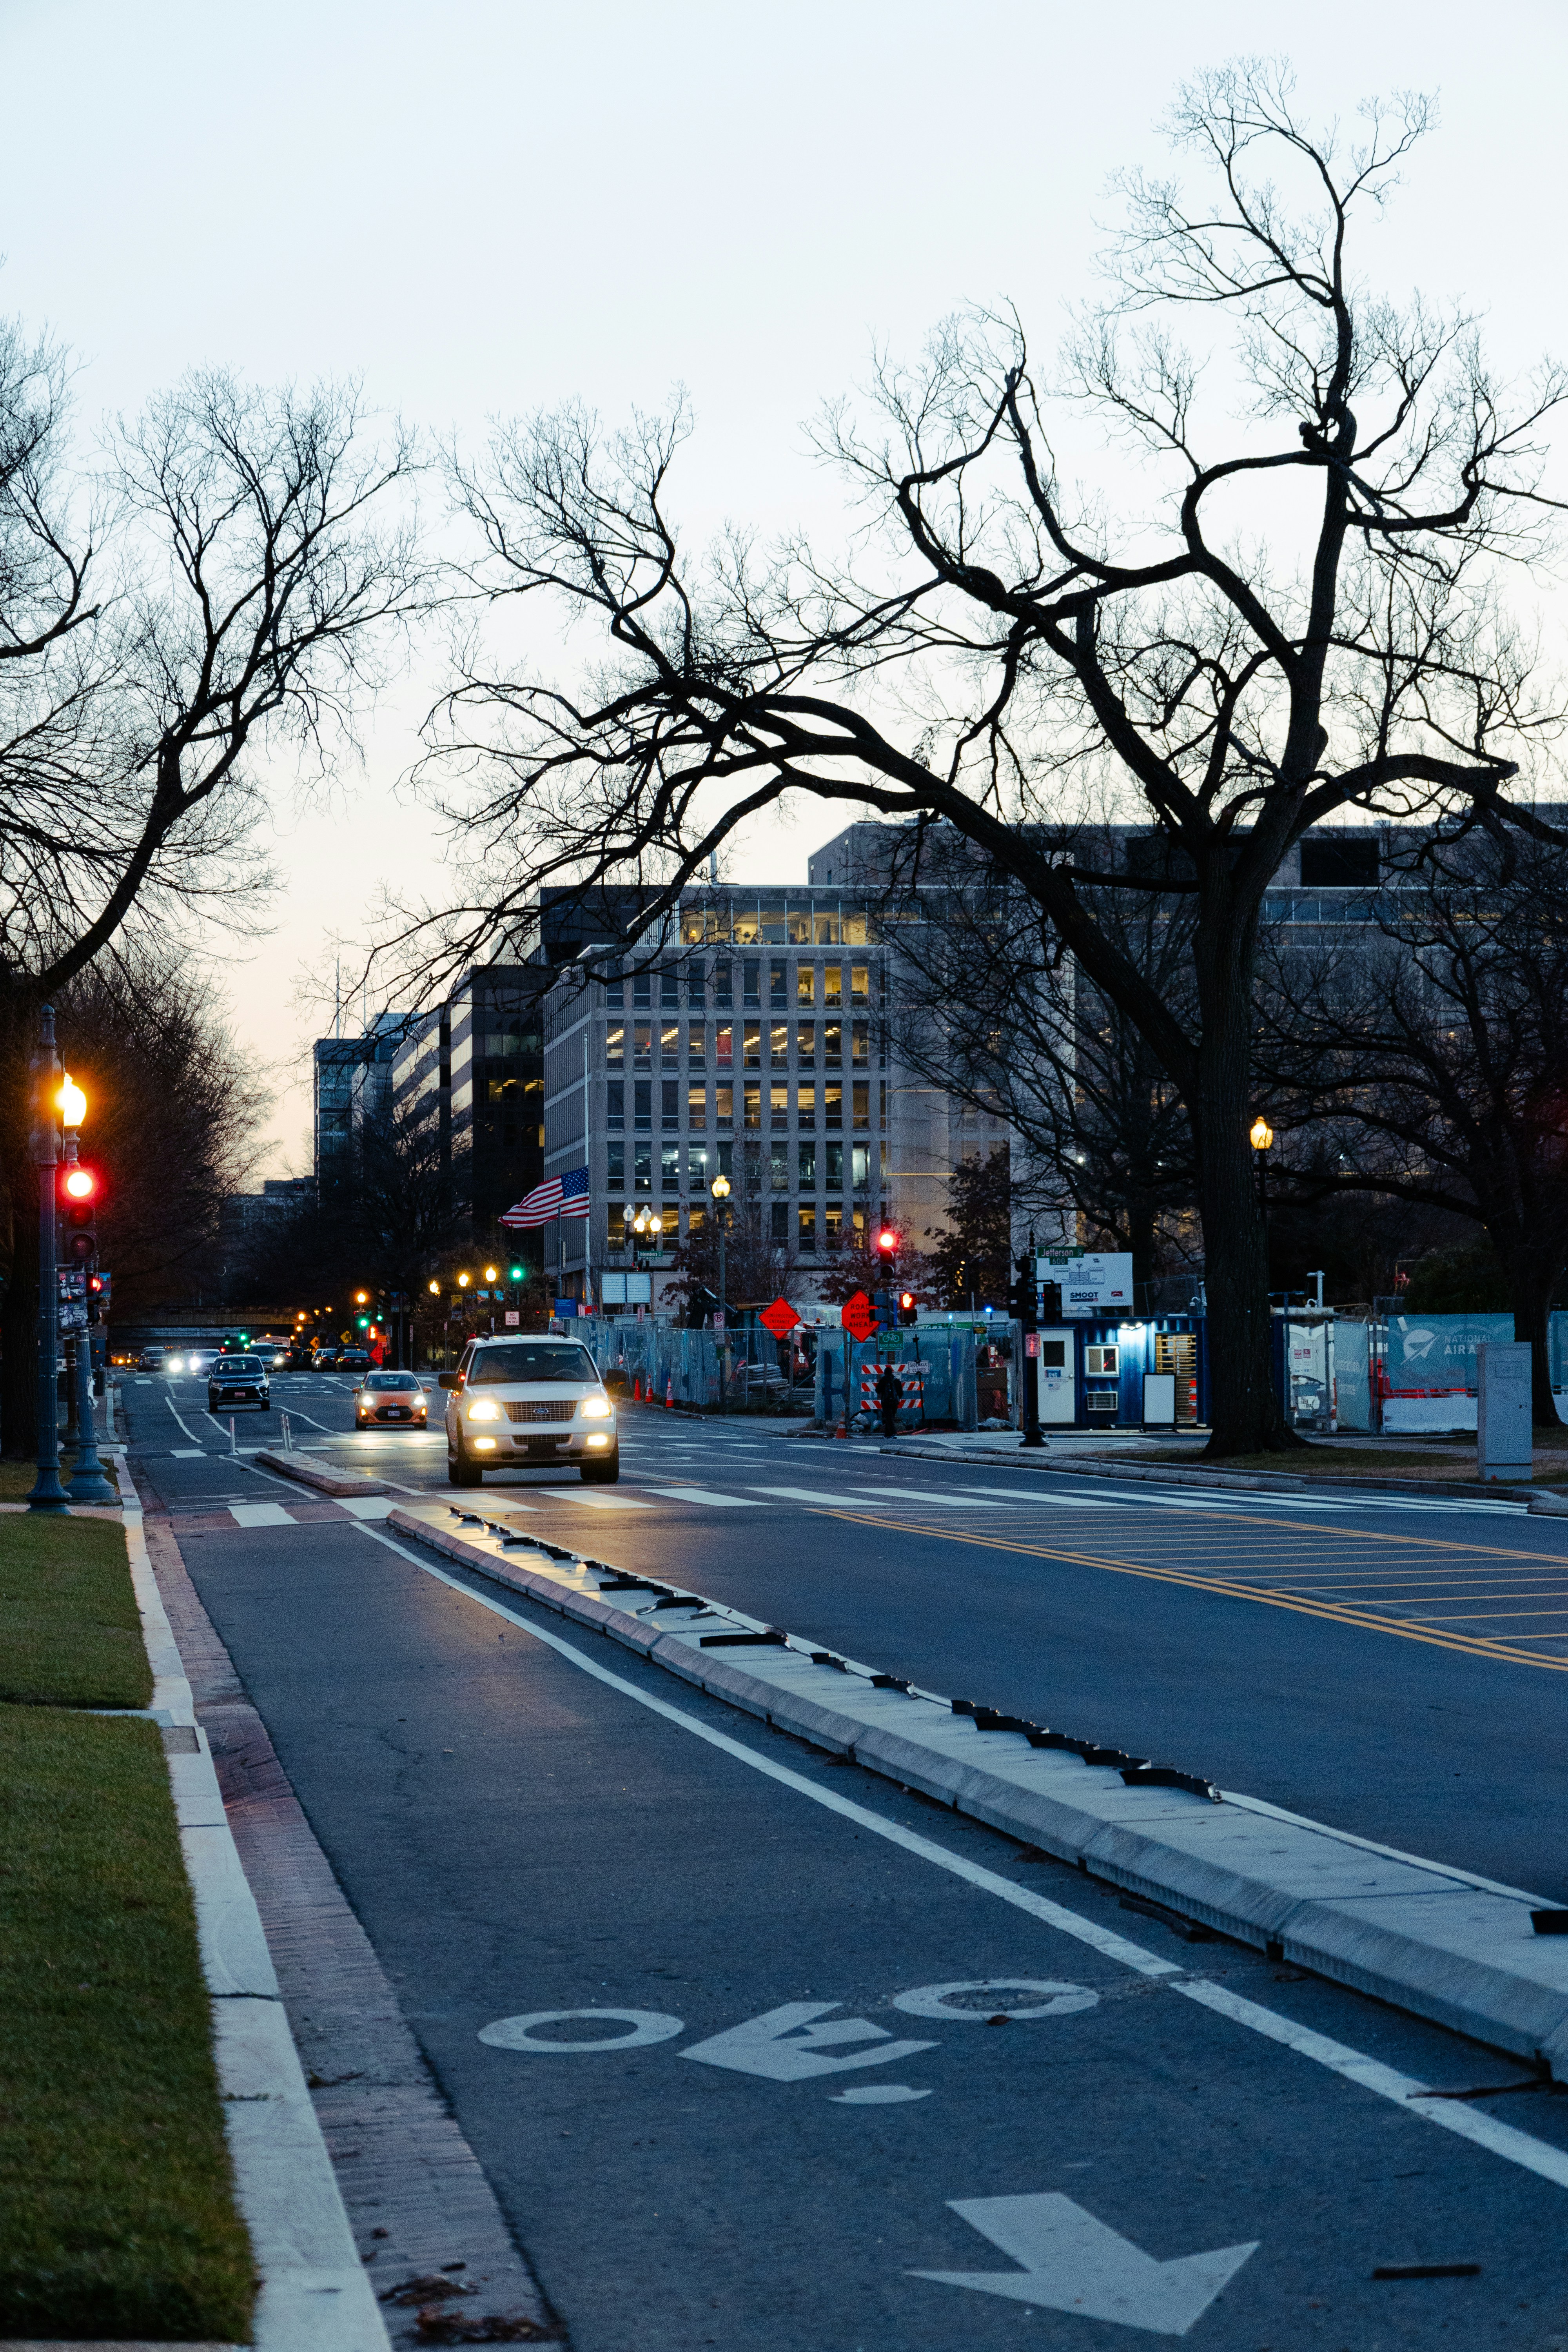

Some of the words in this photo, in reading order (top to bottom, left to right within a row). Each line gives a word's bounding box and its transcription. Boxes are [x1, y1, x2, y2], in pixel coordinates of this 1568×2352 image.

[1041, 1248, 1074, 1257] Jefferson
[1444, 1335, 1492, 1343] NATIONAL
[1444, 1345, 1466, 1355] AIR
[931, 1376, 944, 1385] Ave
